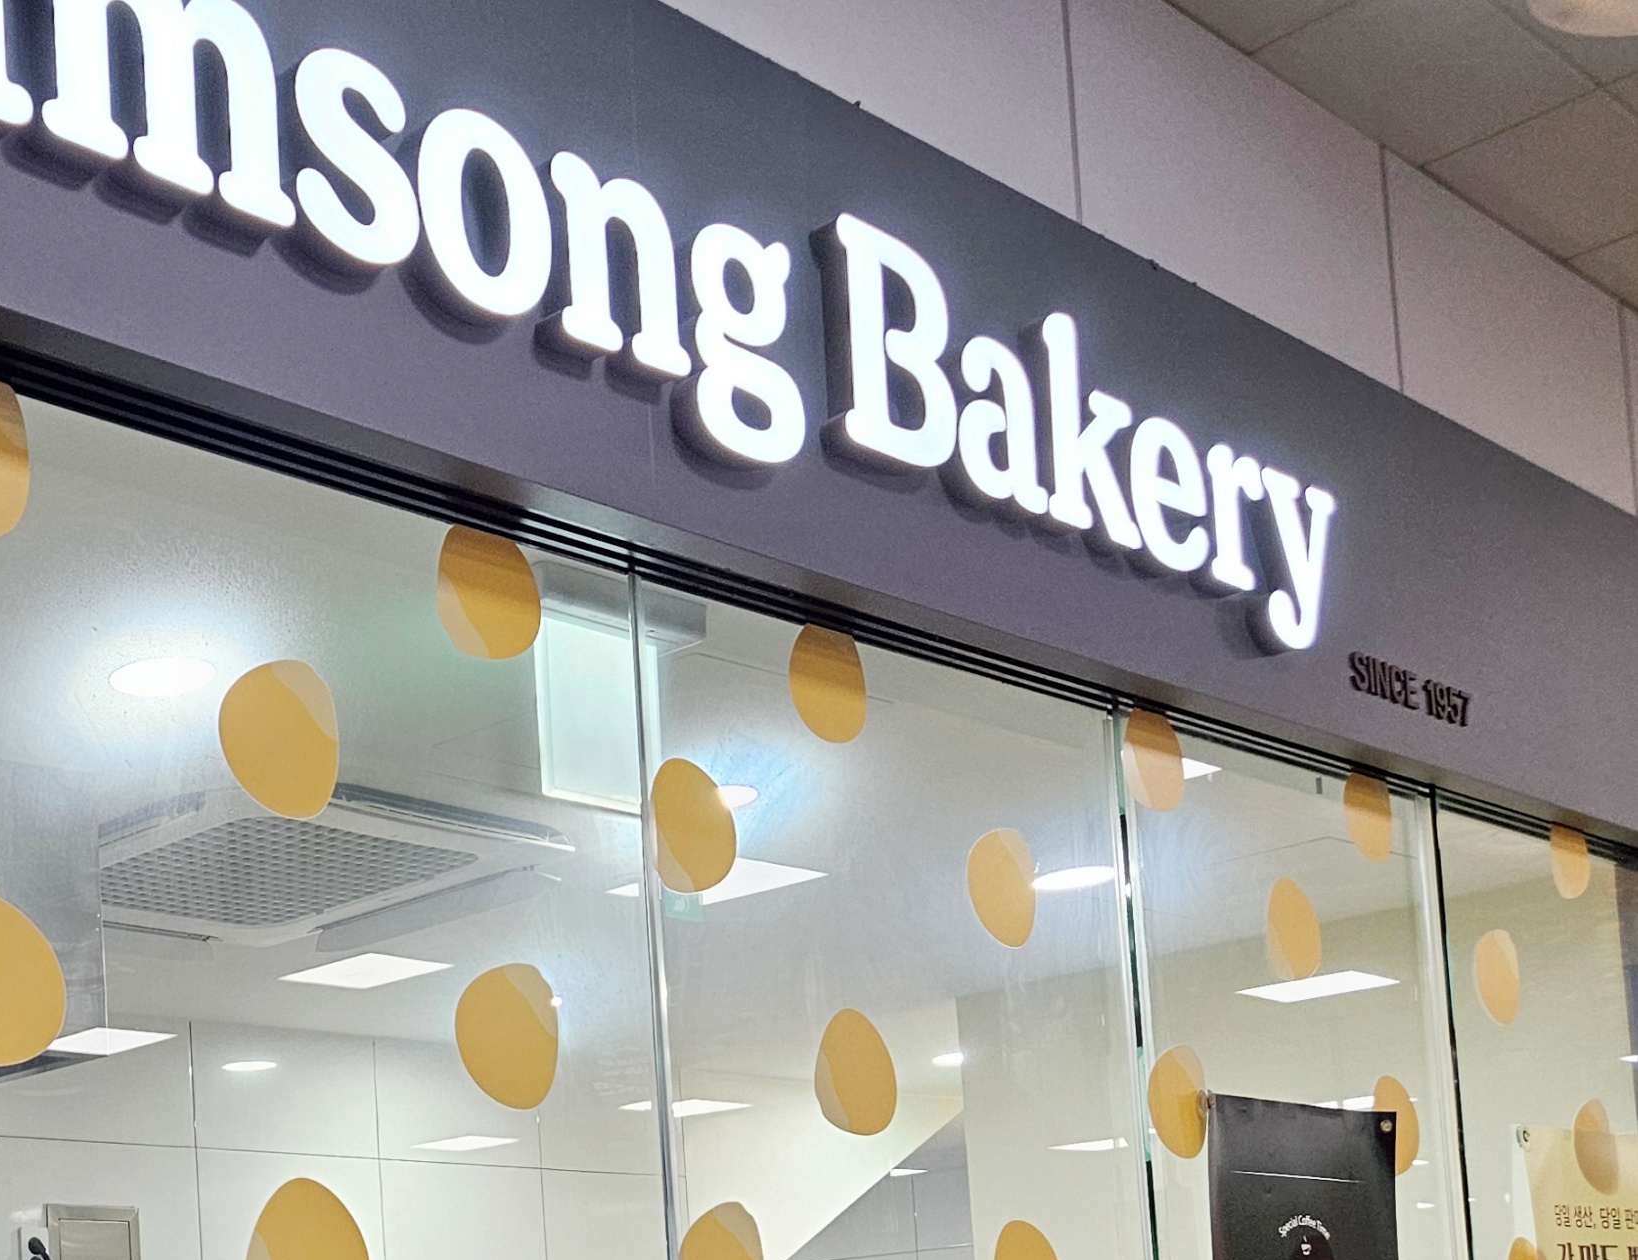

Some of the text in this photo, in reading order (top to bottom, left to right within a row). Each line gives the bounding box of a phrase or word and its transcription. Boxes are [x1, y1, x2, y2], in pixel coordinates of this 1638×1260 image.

[836, 211, 1338, 653] Bakery
[1349, 651, 1471, 727] SINCE 1957
[1555, 1204, 1571, 1228] 당일
[1574, 1205, 1596, 1230] 생산,
[1599, 1206, 1621, 1230] 당일
